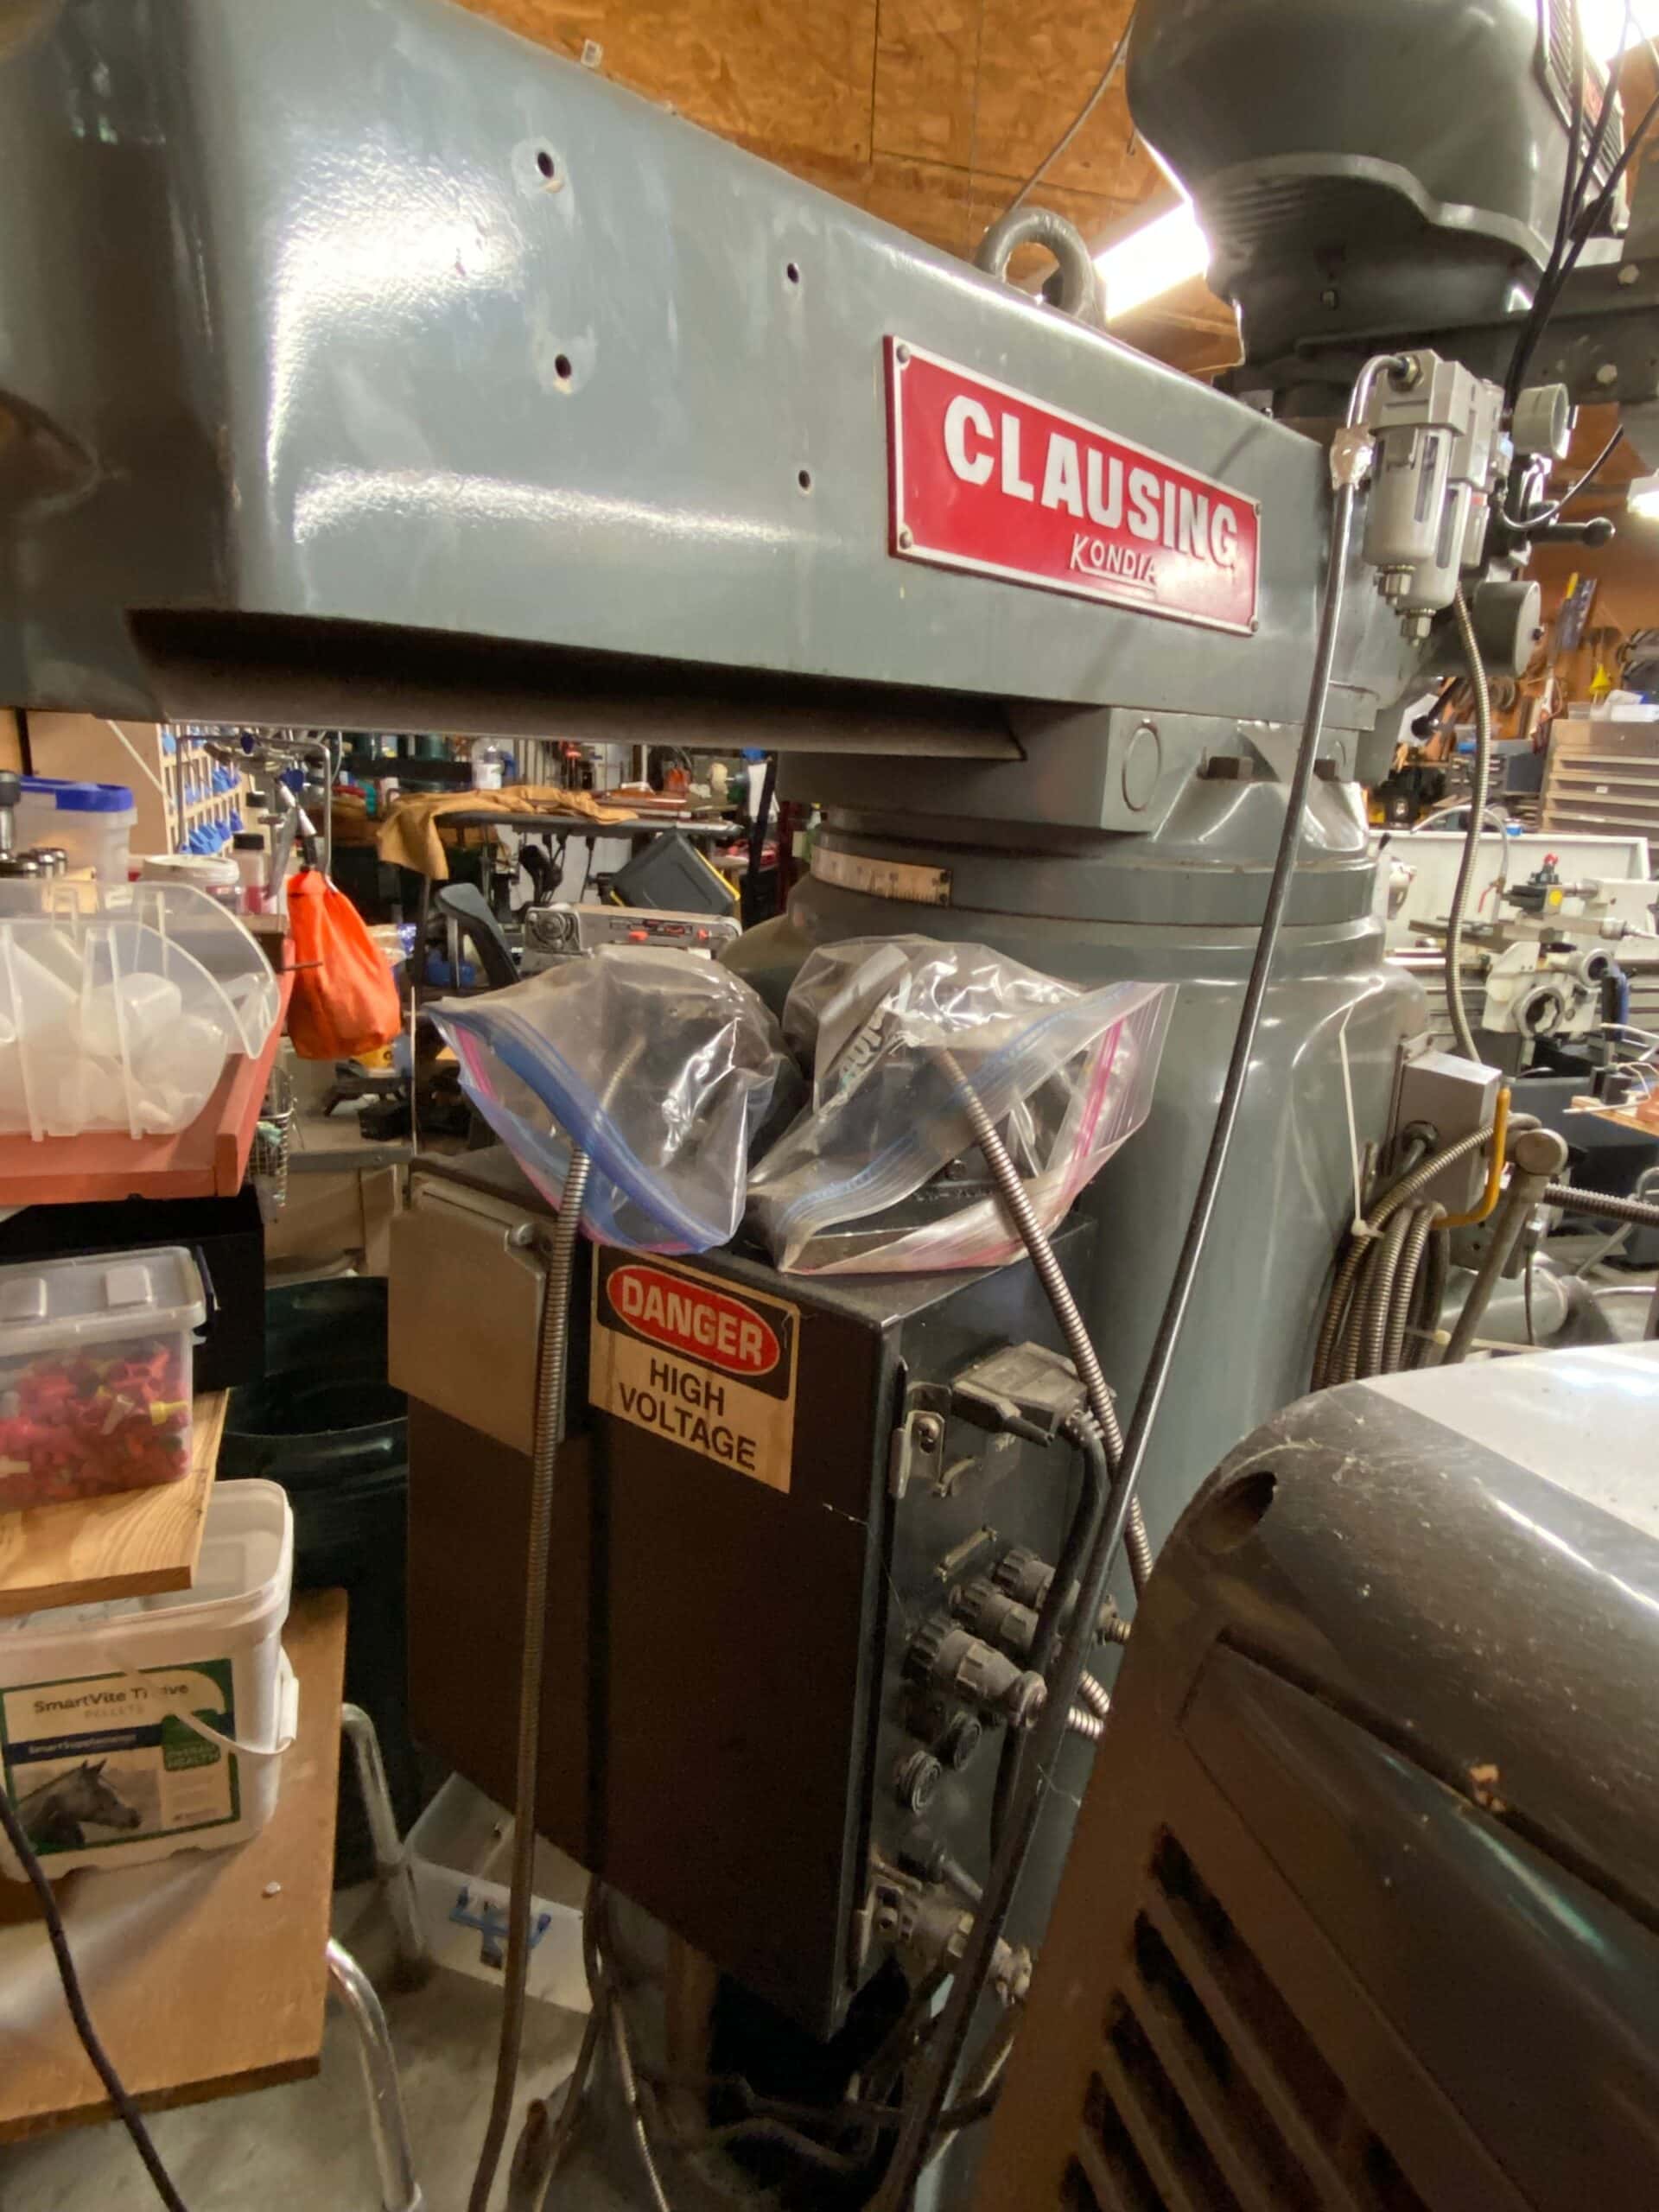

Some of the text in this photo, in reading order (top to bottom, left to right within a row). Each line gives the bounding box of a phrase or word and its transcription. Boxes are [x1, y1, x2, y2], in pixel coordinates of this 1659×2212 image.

[944, 395, 1238, 568] CLAUSING
[621, 1274, 763, 1366] DANGER
[619, 1382, 757, 1471] VOLTAGE
[650, 1357, 725, 1417] HIGH
[33, 1683, 189, 1714] SmartVite Tive
